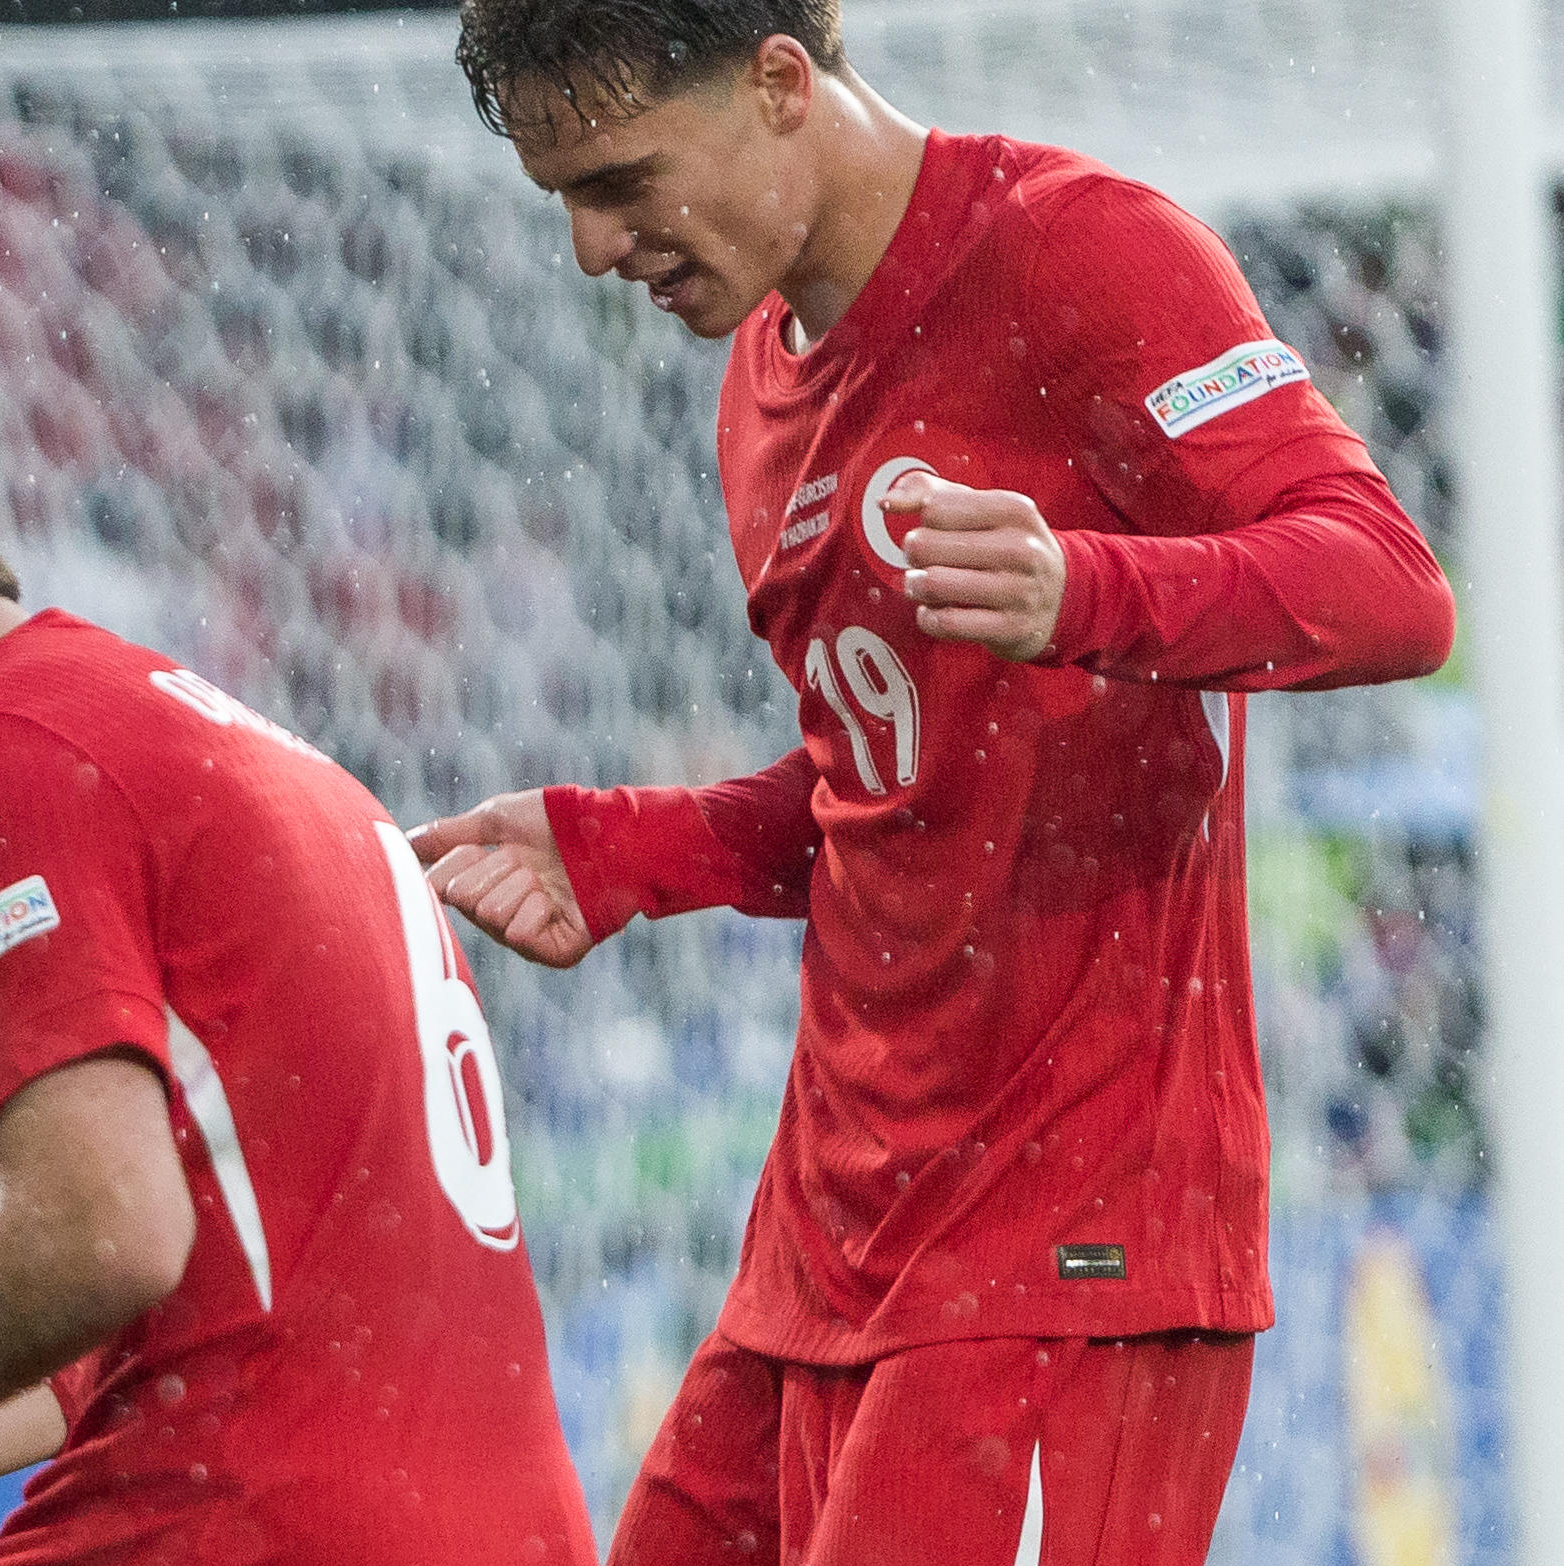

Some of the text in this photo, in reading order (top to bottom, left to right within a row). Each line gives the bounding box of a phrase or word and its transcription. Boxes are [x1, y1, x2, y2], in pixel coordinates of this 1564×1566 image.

[1157, 351, 1296, 421] FOUNDATION
[805, 626, 919, 795] 19
[374, 820, 520, 1251] 6
